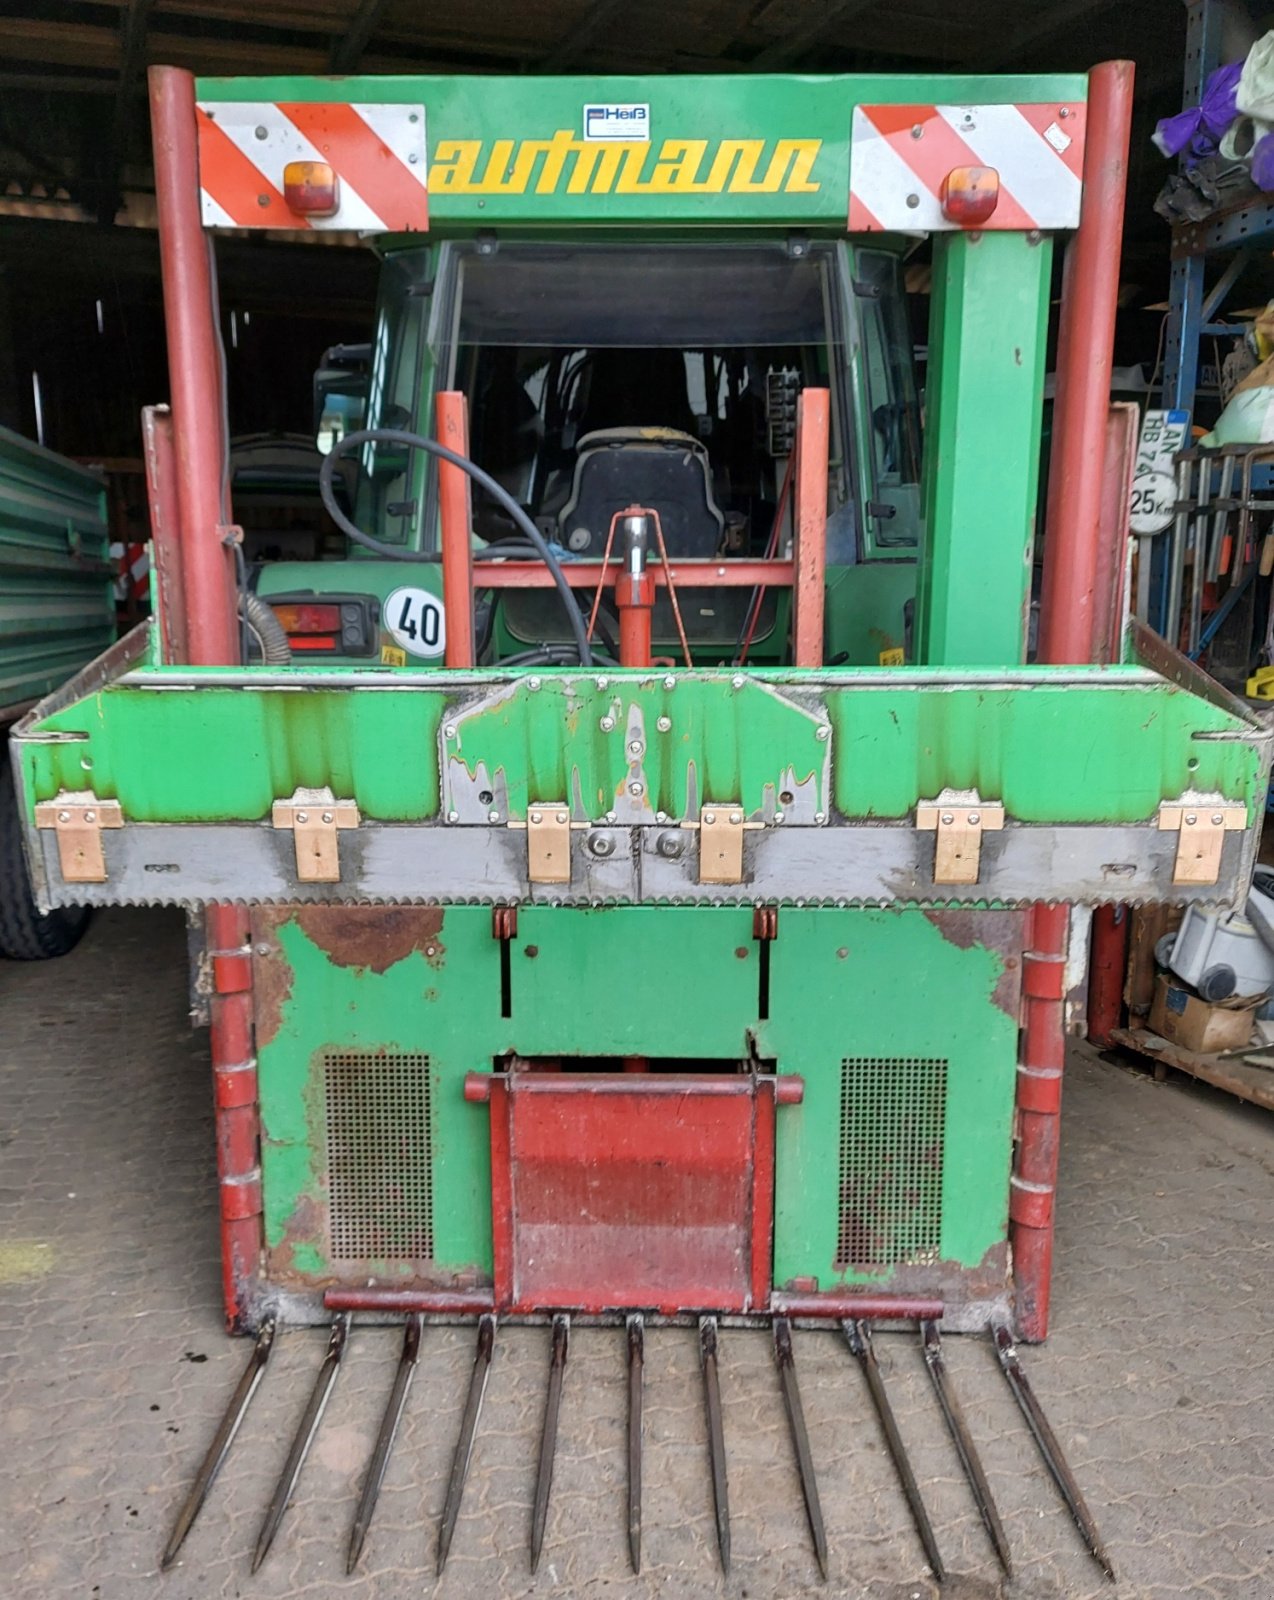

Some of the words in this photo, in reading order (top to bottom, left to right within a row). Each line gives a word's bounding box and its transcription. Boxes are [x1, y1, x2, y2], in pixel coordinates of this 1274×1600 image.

[1143, 417, 1164, 442] HB
[1160, 430, 1181, 454] AN
[399, 597, 440, 647] 40
